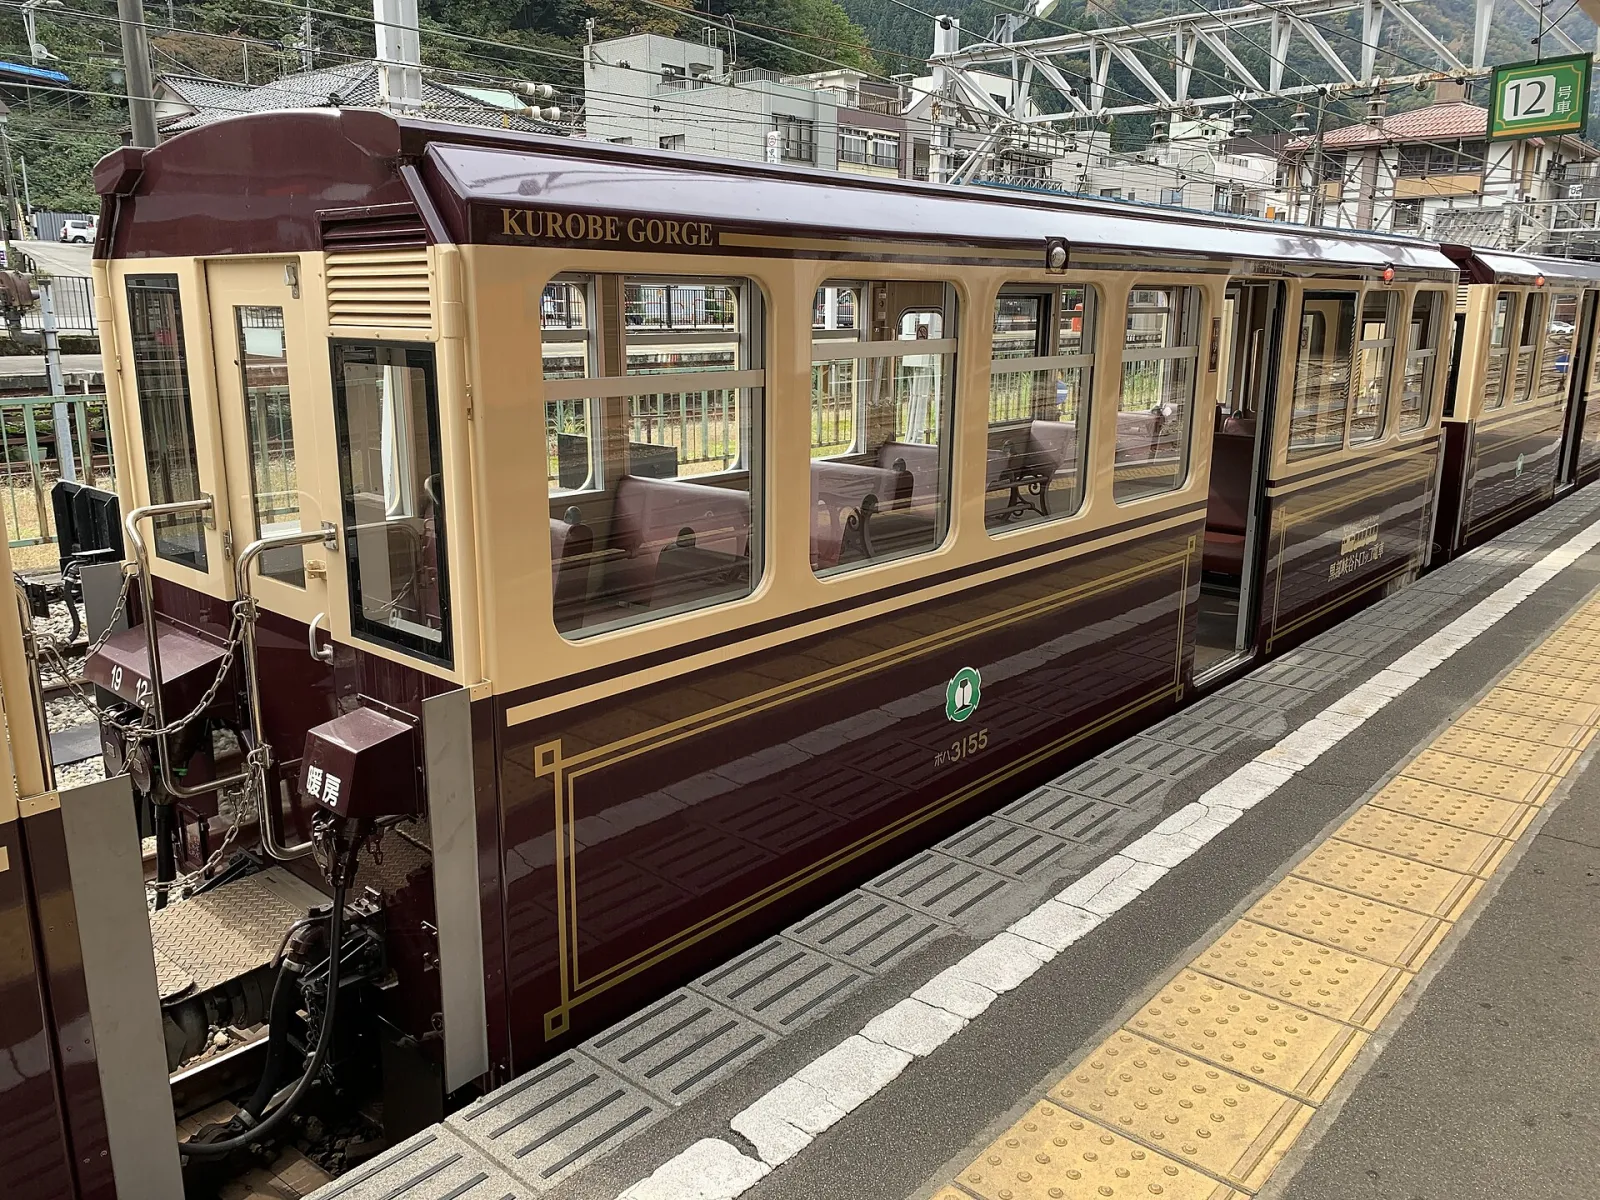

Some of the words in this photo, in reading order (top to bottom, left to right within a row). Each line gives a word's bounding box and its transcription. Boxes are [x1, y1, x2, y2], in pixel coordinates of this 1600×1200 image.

[1509, 81, 1546, 116] 12
[1556, 85, 1572, 114] 号車
[500, 208, 620, 241] KUROBE
[627, 217, 713, 246] GORGE
[111, 664, 123, 691] 19
[136, 678, 153, 702] 12
[306, 765, 341, 807] 暖房
